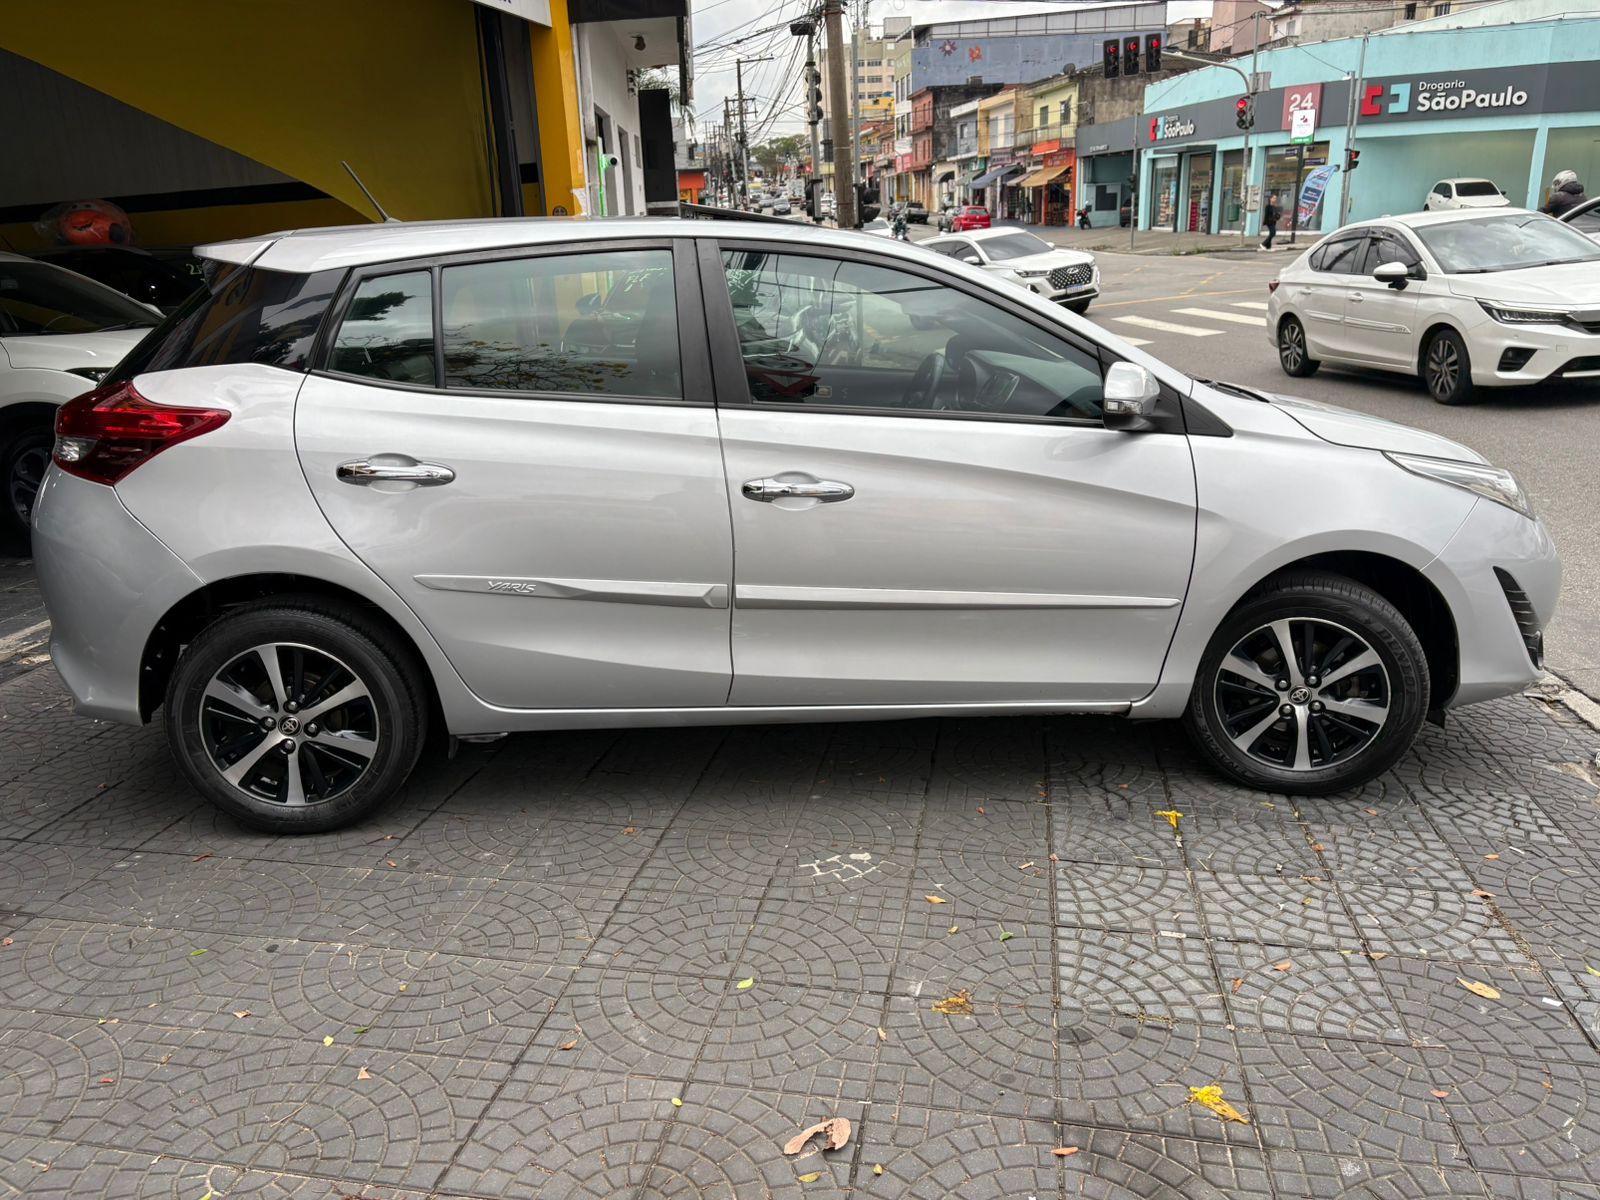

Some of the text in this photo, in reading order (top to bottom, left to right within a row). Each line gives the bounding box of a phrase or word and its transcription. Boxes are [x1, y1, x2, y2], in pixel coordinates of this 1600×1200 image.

[1418, 79, 1466, 92] Drogaria
[1288, 92, 1314, 112] 24
[1416, 85, 1528, 112] SãoPaulo
[487, 580, 537, 593] YARIS
